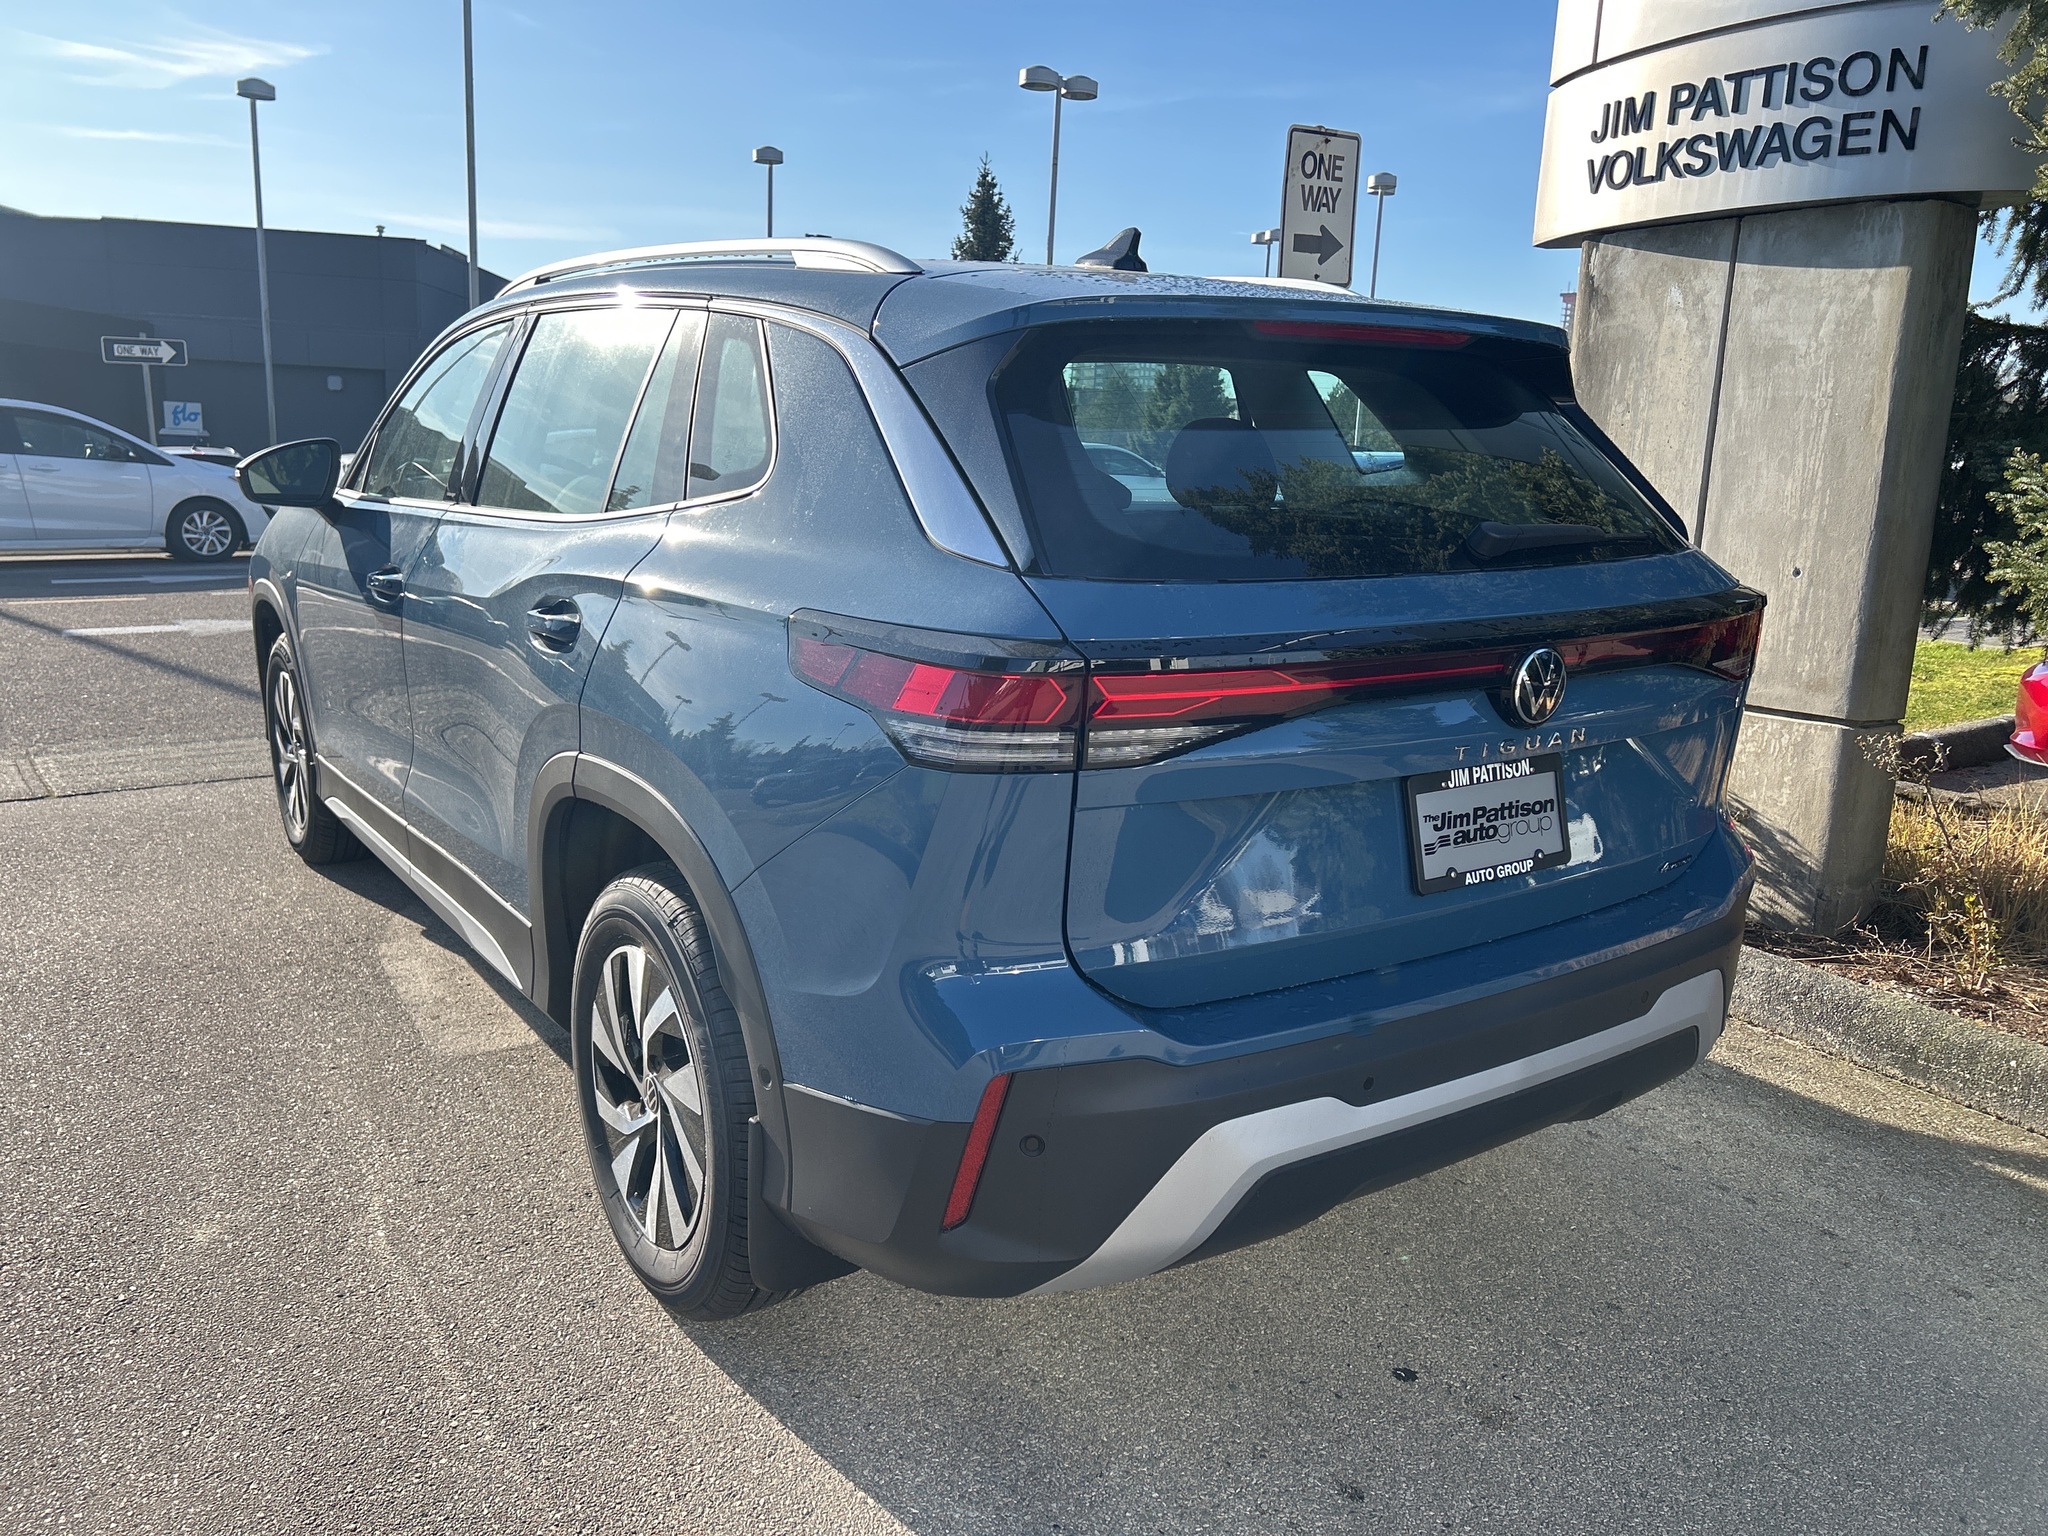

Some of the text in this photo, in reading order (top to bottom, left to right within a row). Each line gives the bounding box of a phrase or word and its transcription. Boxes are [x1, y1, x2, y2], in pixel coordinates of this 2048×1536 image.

[1590, 45, 1929, 144] JIM PATTISON
[1587, 106, 1921, 194] VOLKSWAGEN
[1301, 150, 1345, 182] ONE
[1301, 184, 1342, 213] WAY
[116, 345, 159, 357] ONE WAY
[172, 402, 200, 426] flo
[1454, 727, 1586, 761] TIGUAN
[1448, 758, 1530, 789] JIM PATTISON
[1423, 814, 1439, 824] The
[1465, 859, 1534, 885] AUTO GROUP
